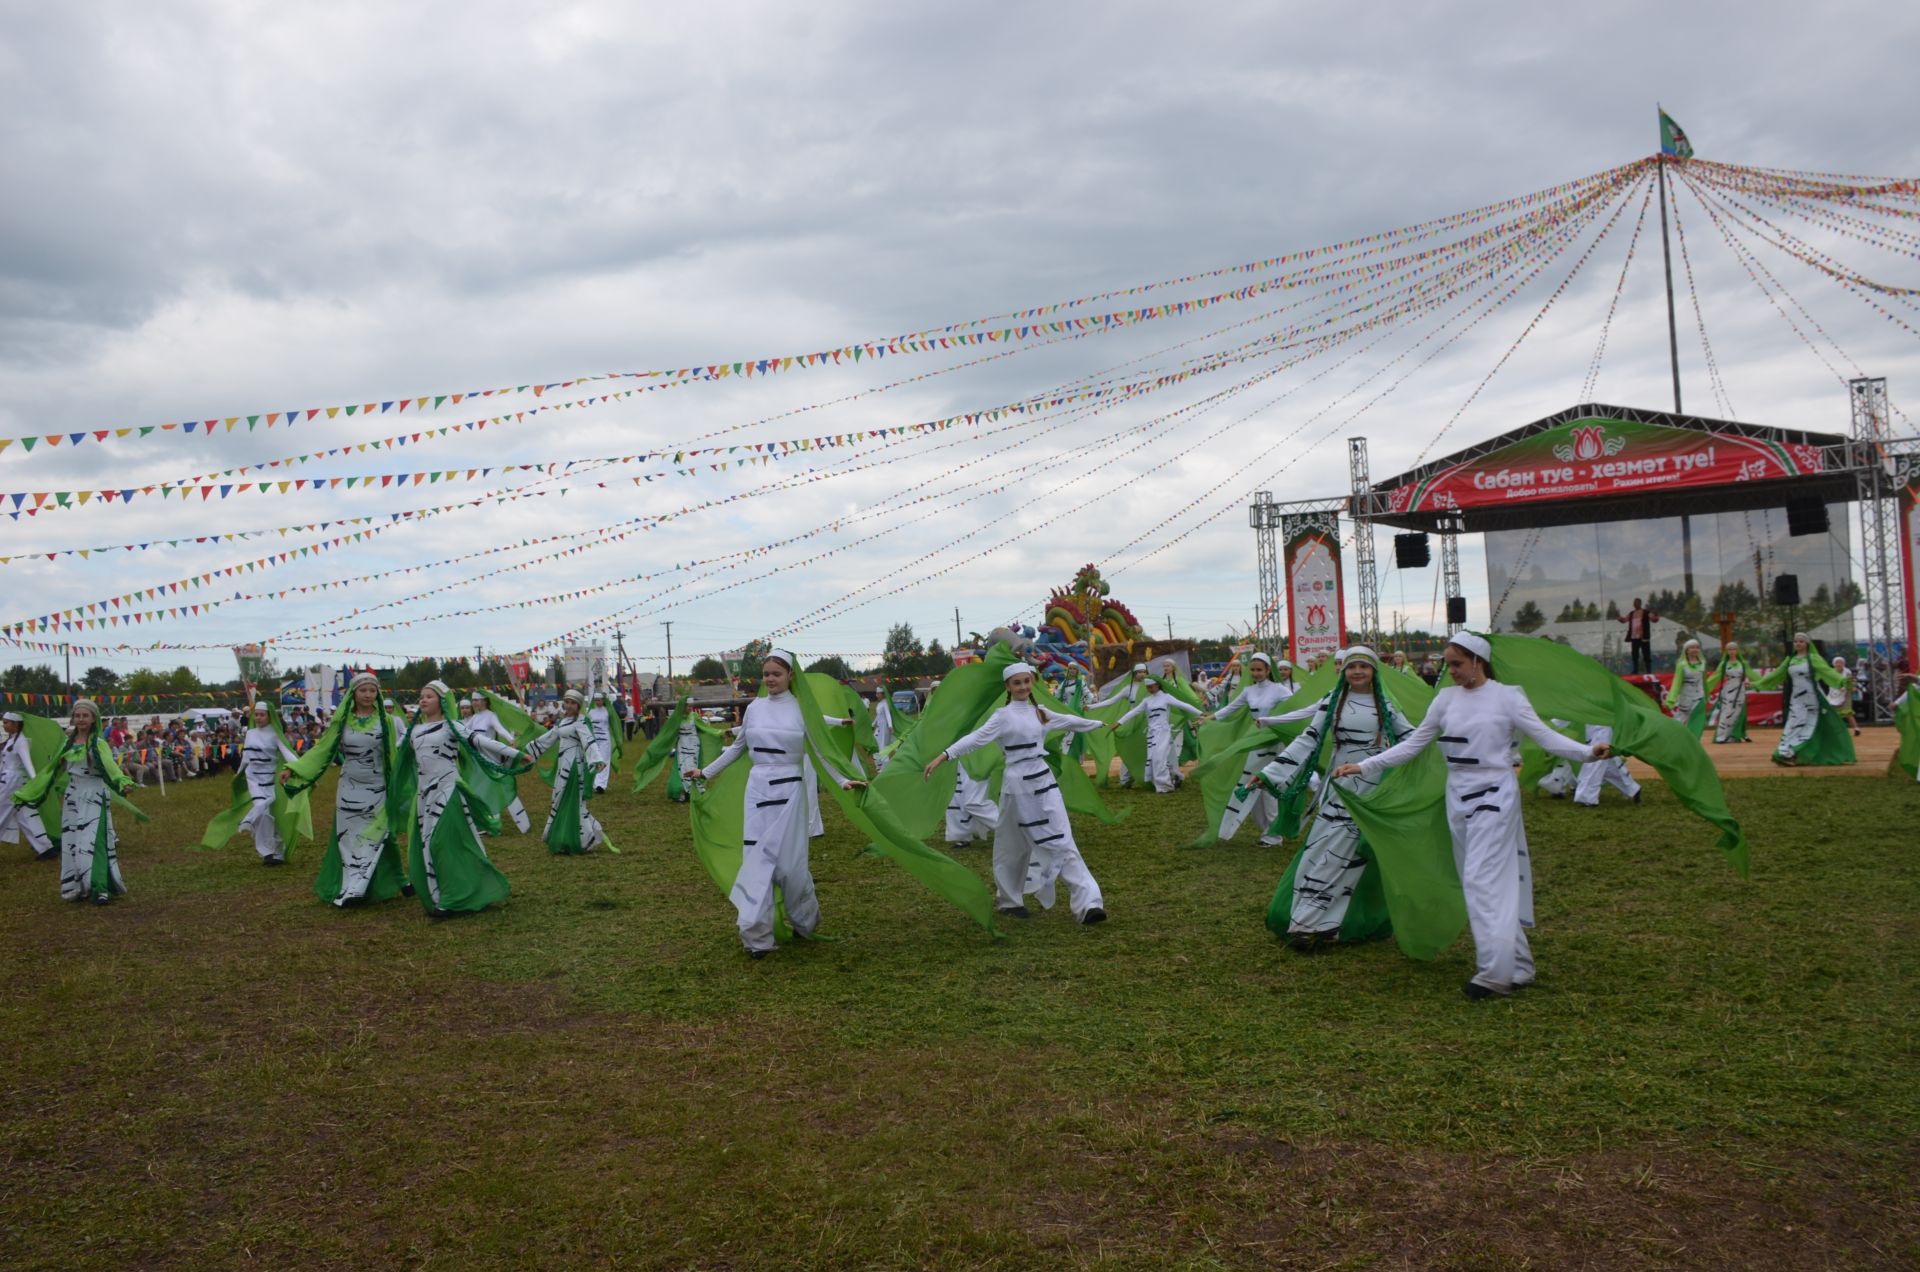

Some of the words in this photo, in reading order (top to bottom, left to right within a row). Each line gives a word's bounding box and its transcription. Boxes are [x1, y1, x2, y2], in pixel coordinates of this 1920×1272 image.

[1474, 469, 1535, 490] Сабан
[1541, 467, 1574, 484] туе
[1591, 457, 1667, 479] хезмәт
[1672, 447, 1715, 470] туе!
[1505, 488, 1537, 499] Добро
[1538, 481, 1598, 495] пожаловать!
